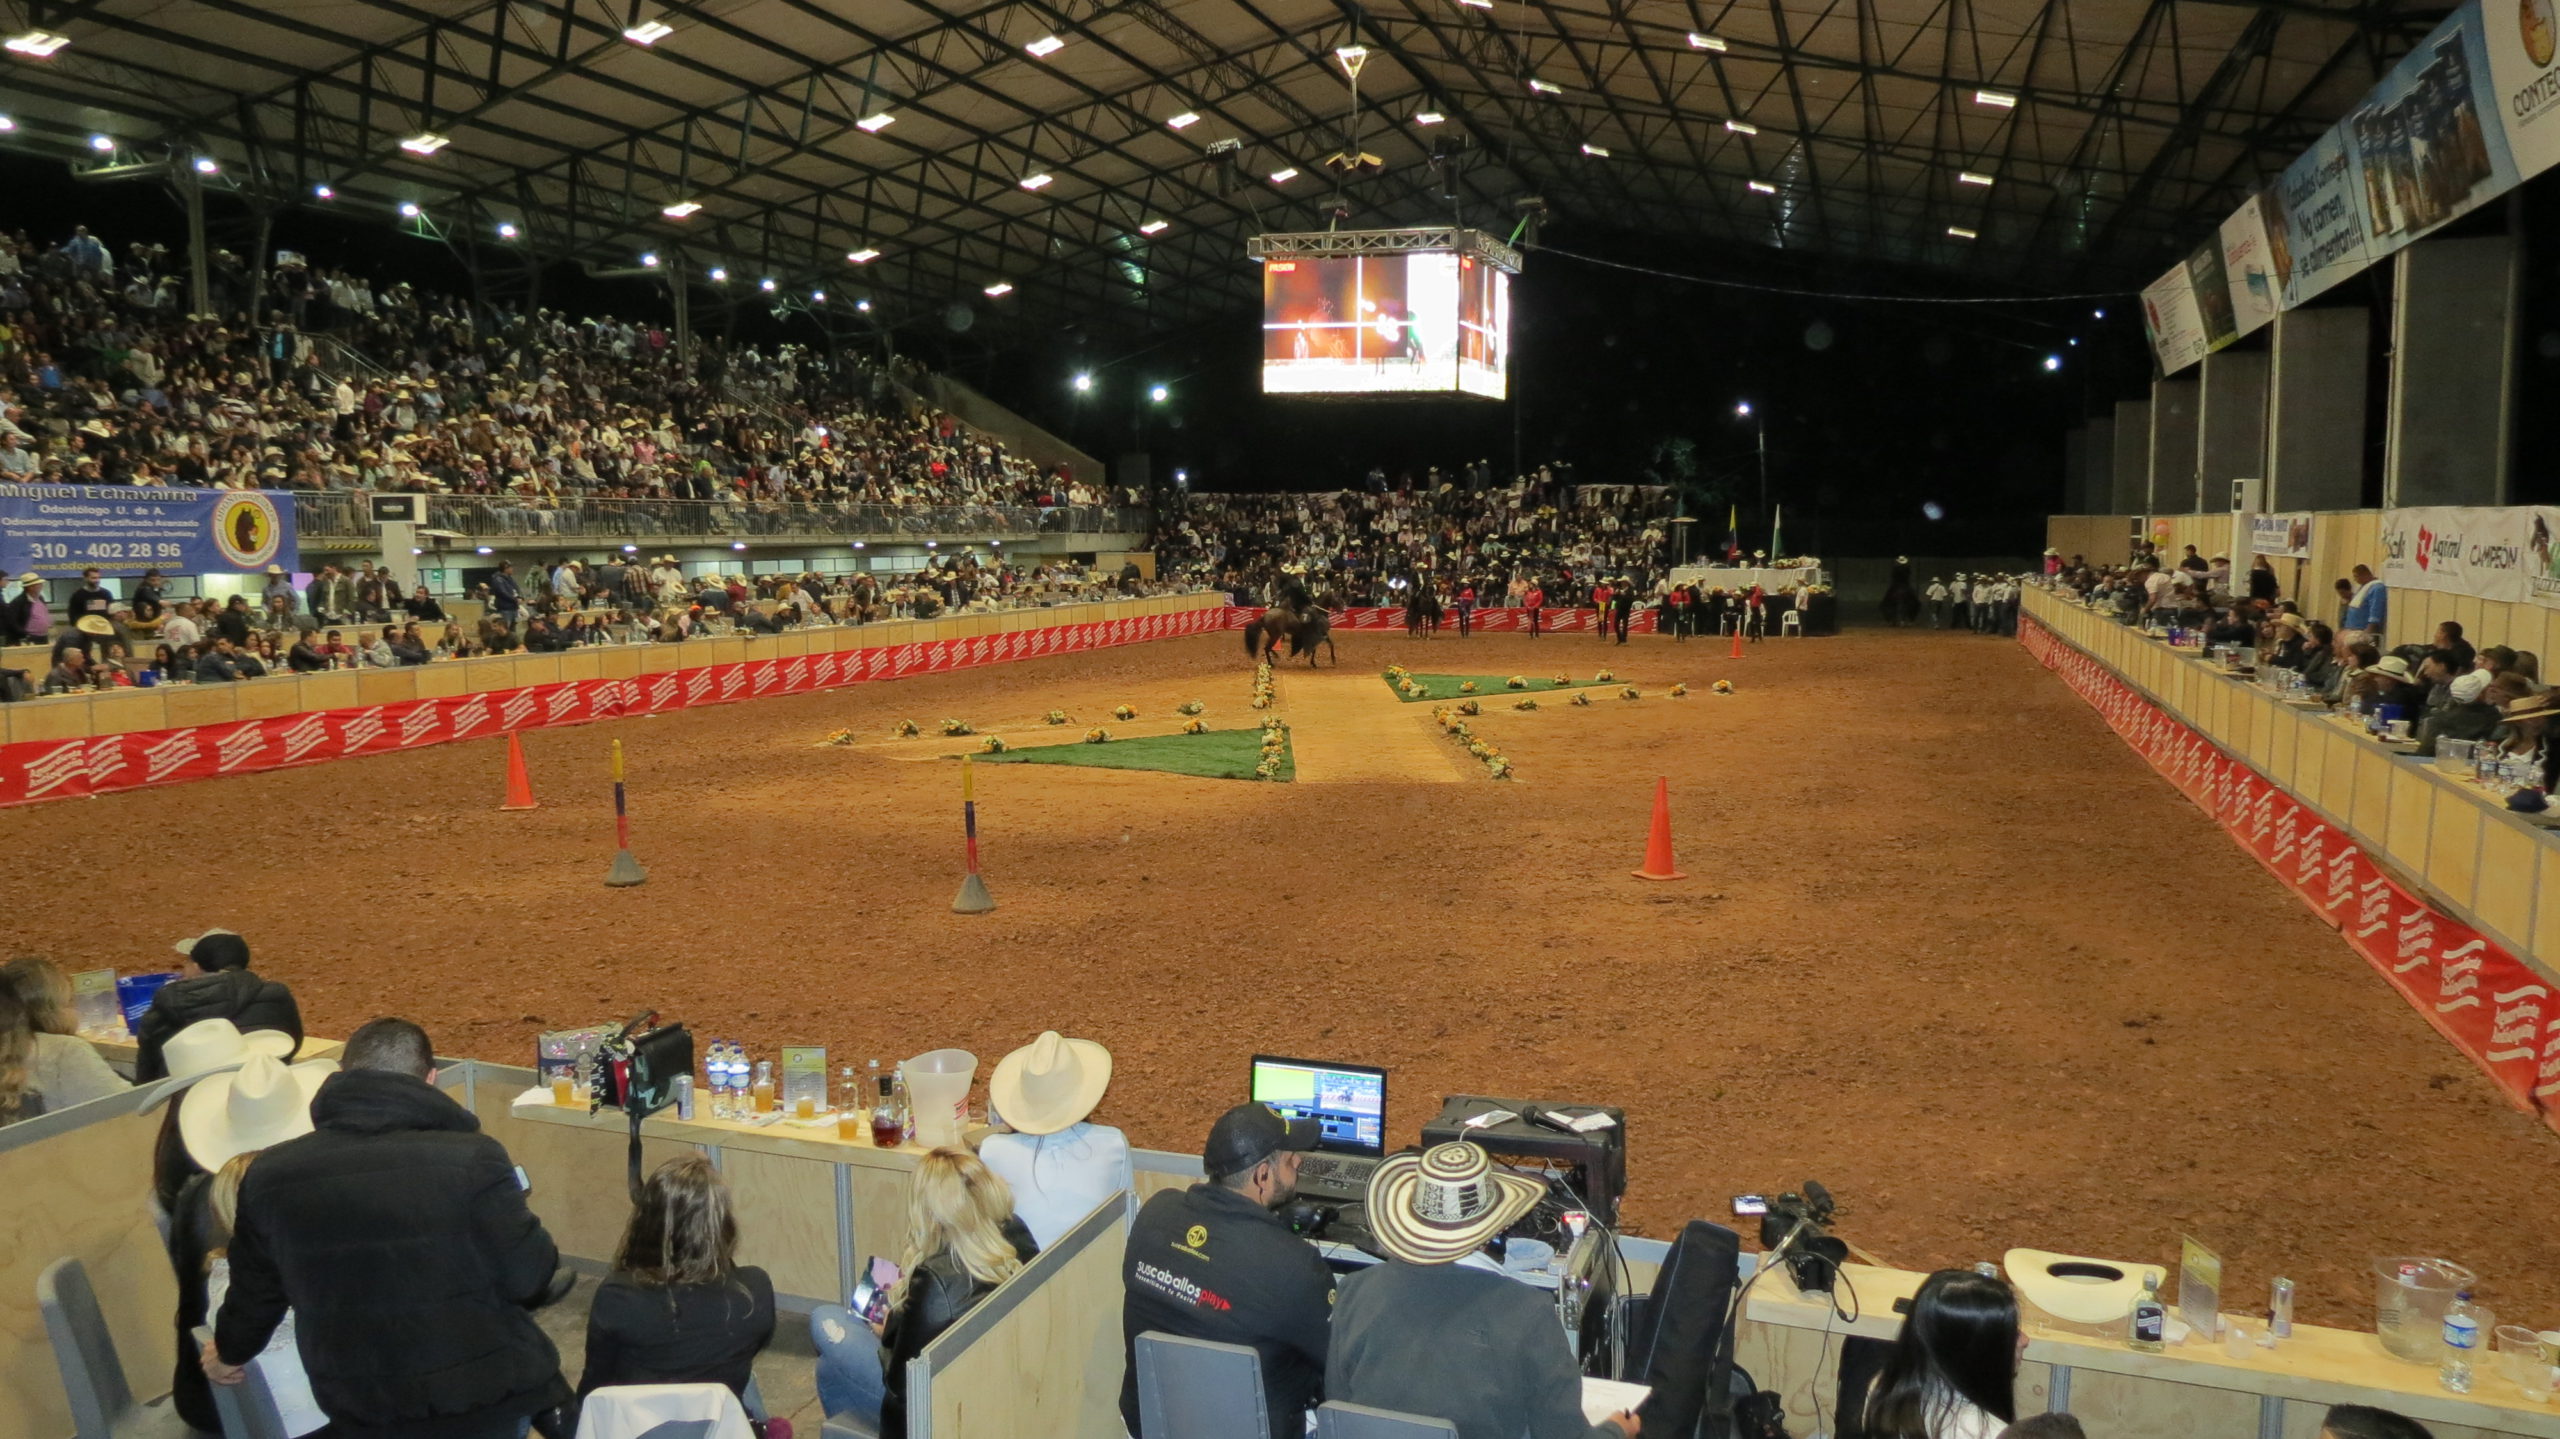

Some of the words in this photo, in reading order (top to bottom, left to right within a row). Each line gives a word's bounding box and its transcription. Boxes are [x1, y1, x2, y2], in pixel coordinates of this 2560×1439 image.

[134, 506, 149, 515] de
[31, 543, 67, 558] 310
[87, 543, 123, 558] 402
[129, 543, 152, 557] 28
[157, 543, 181, 557] 96
